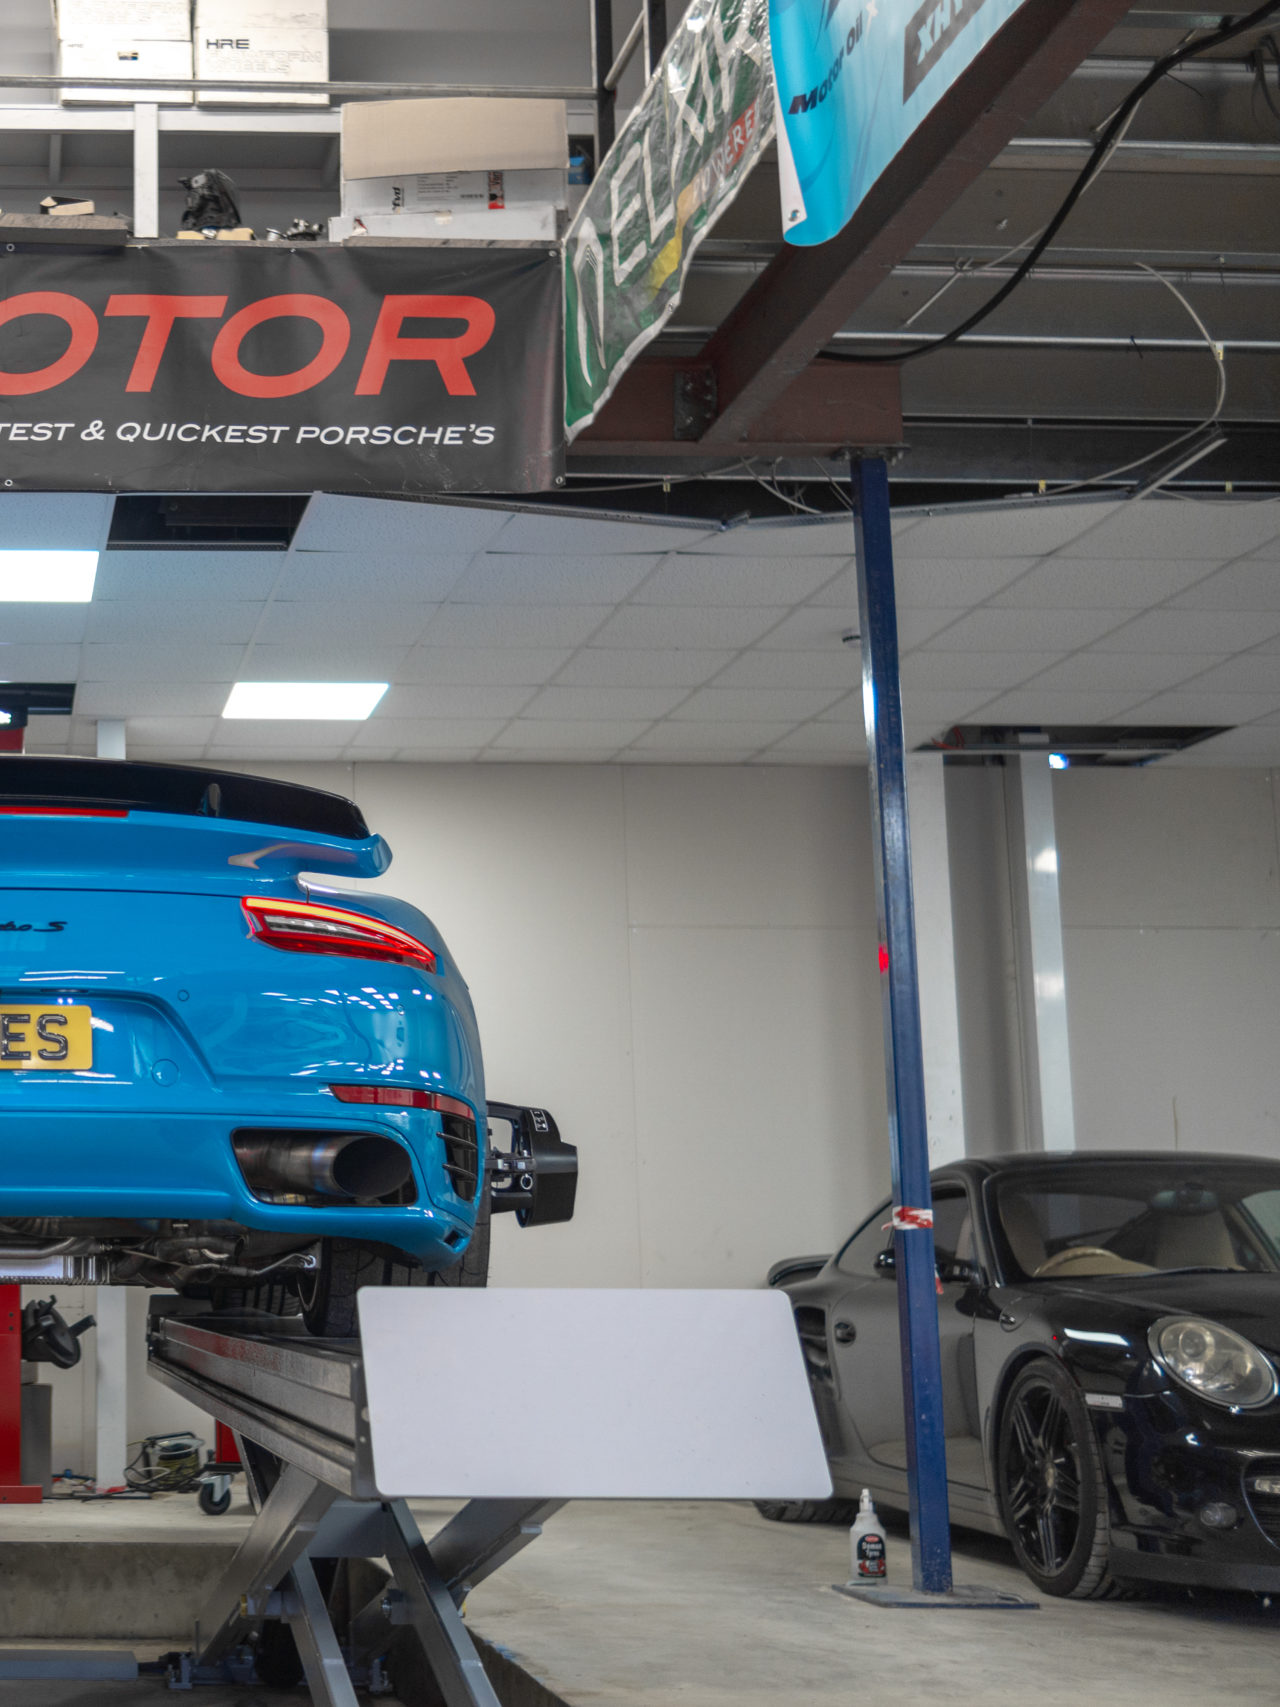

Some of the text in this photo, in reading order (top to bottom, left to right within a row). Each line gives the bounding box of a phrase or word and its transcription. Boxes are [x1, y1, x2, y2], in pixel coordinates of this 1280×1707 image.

[206, 39, 250, 50] HRE
[788, 46, 844, 115] Motor
[80, 419, 106, 441] &
[115, 422, 290, 444] QUICKEST
[295, 423, 497, 446] PORSCHE'S
[0, 1014, 68, 1061] ES
